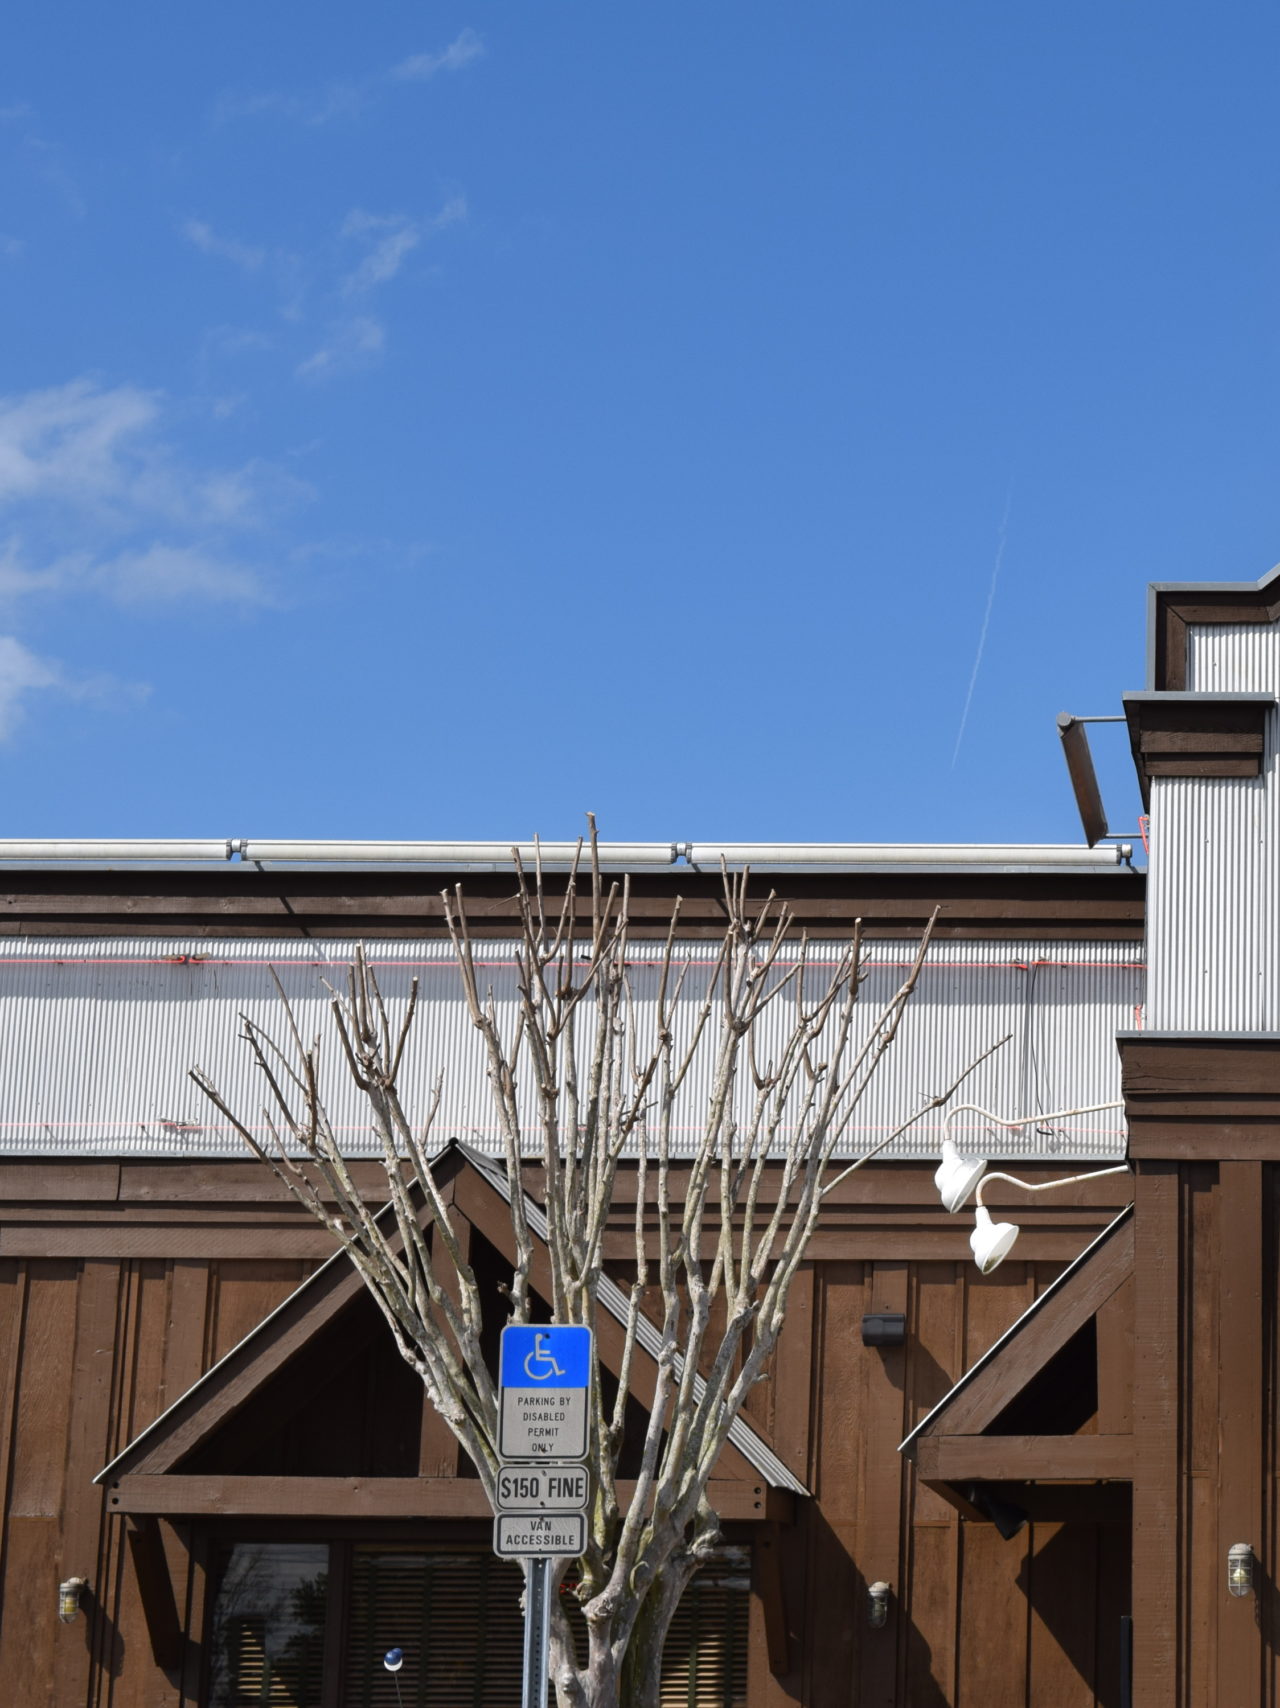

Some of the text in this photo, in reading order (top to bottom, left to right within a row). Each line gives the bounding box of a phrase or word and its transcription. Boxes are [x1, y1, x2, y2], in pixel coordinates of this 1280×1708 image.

[517, 1396, 571, 1407] PARKING BY
[522, 1411, 566, 1422] DISABLED
[527, 1427, 560, 1438] PERMIT
[531, 1442, 554, 1453] ONLY
[500, 1476, 585, 1499] $150 FINE
[530, 1520, 552, 1532] VAN
[505, 1534, 575, 1546] ACCESSIBLE
